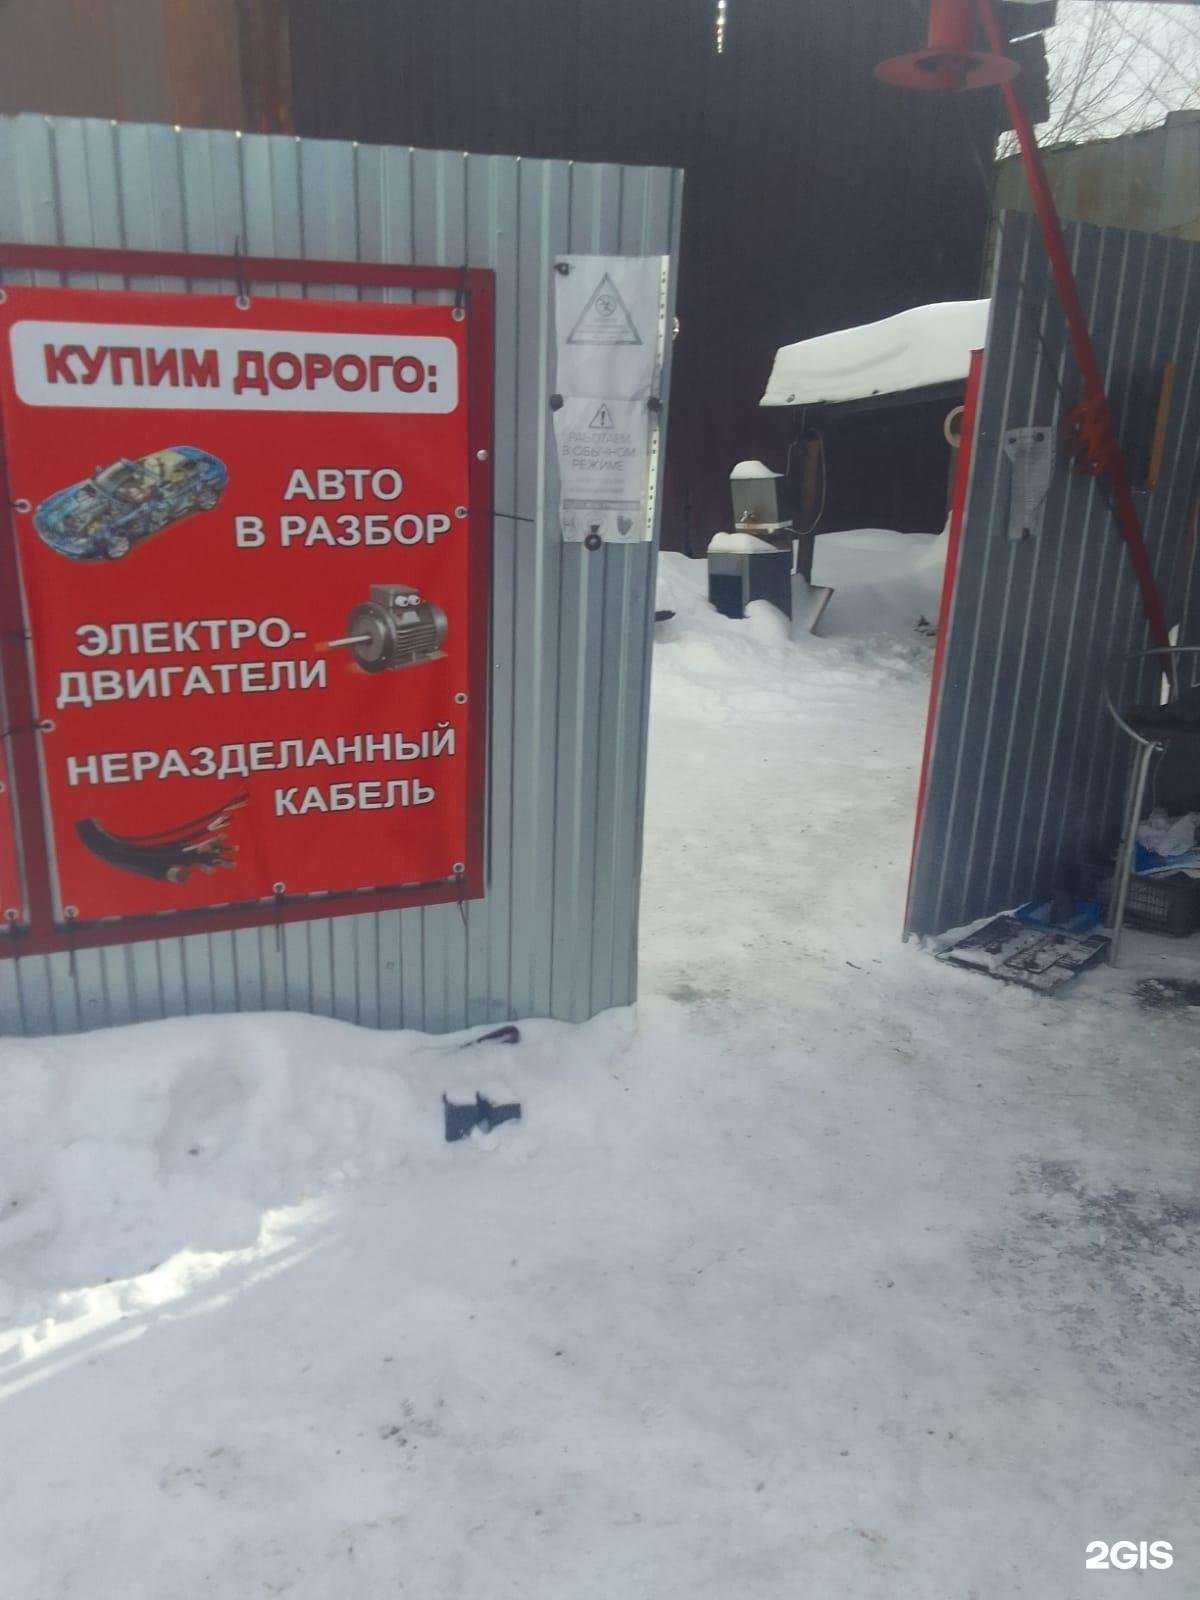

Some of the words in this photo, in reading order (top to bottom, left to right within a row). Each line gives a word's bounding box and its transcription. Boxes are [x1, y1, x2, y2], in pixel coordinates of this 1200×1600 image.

[43, 343, 220, 387] КУПИМ
[233, 351, 437, 395] ДОРОГО:
[284, 468, 403, 501] АВТО
[234, 515, 266, 549] В
[279, 513, 452, 547] РАЗБОР
[74, 616, 307, 657] ЭЛЕКТРО-
[55, 659, 328, 710] ДВИГАТЕЛИ
[65, 721, 457, 787] НЕРАЗДЕЛАННЫЙ
[273, 777, 437, 817] КАБЕЛЬ
